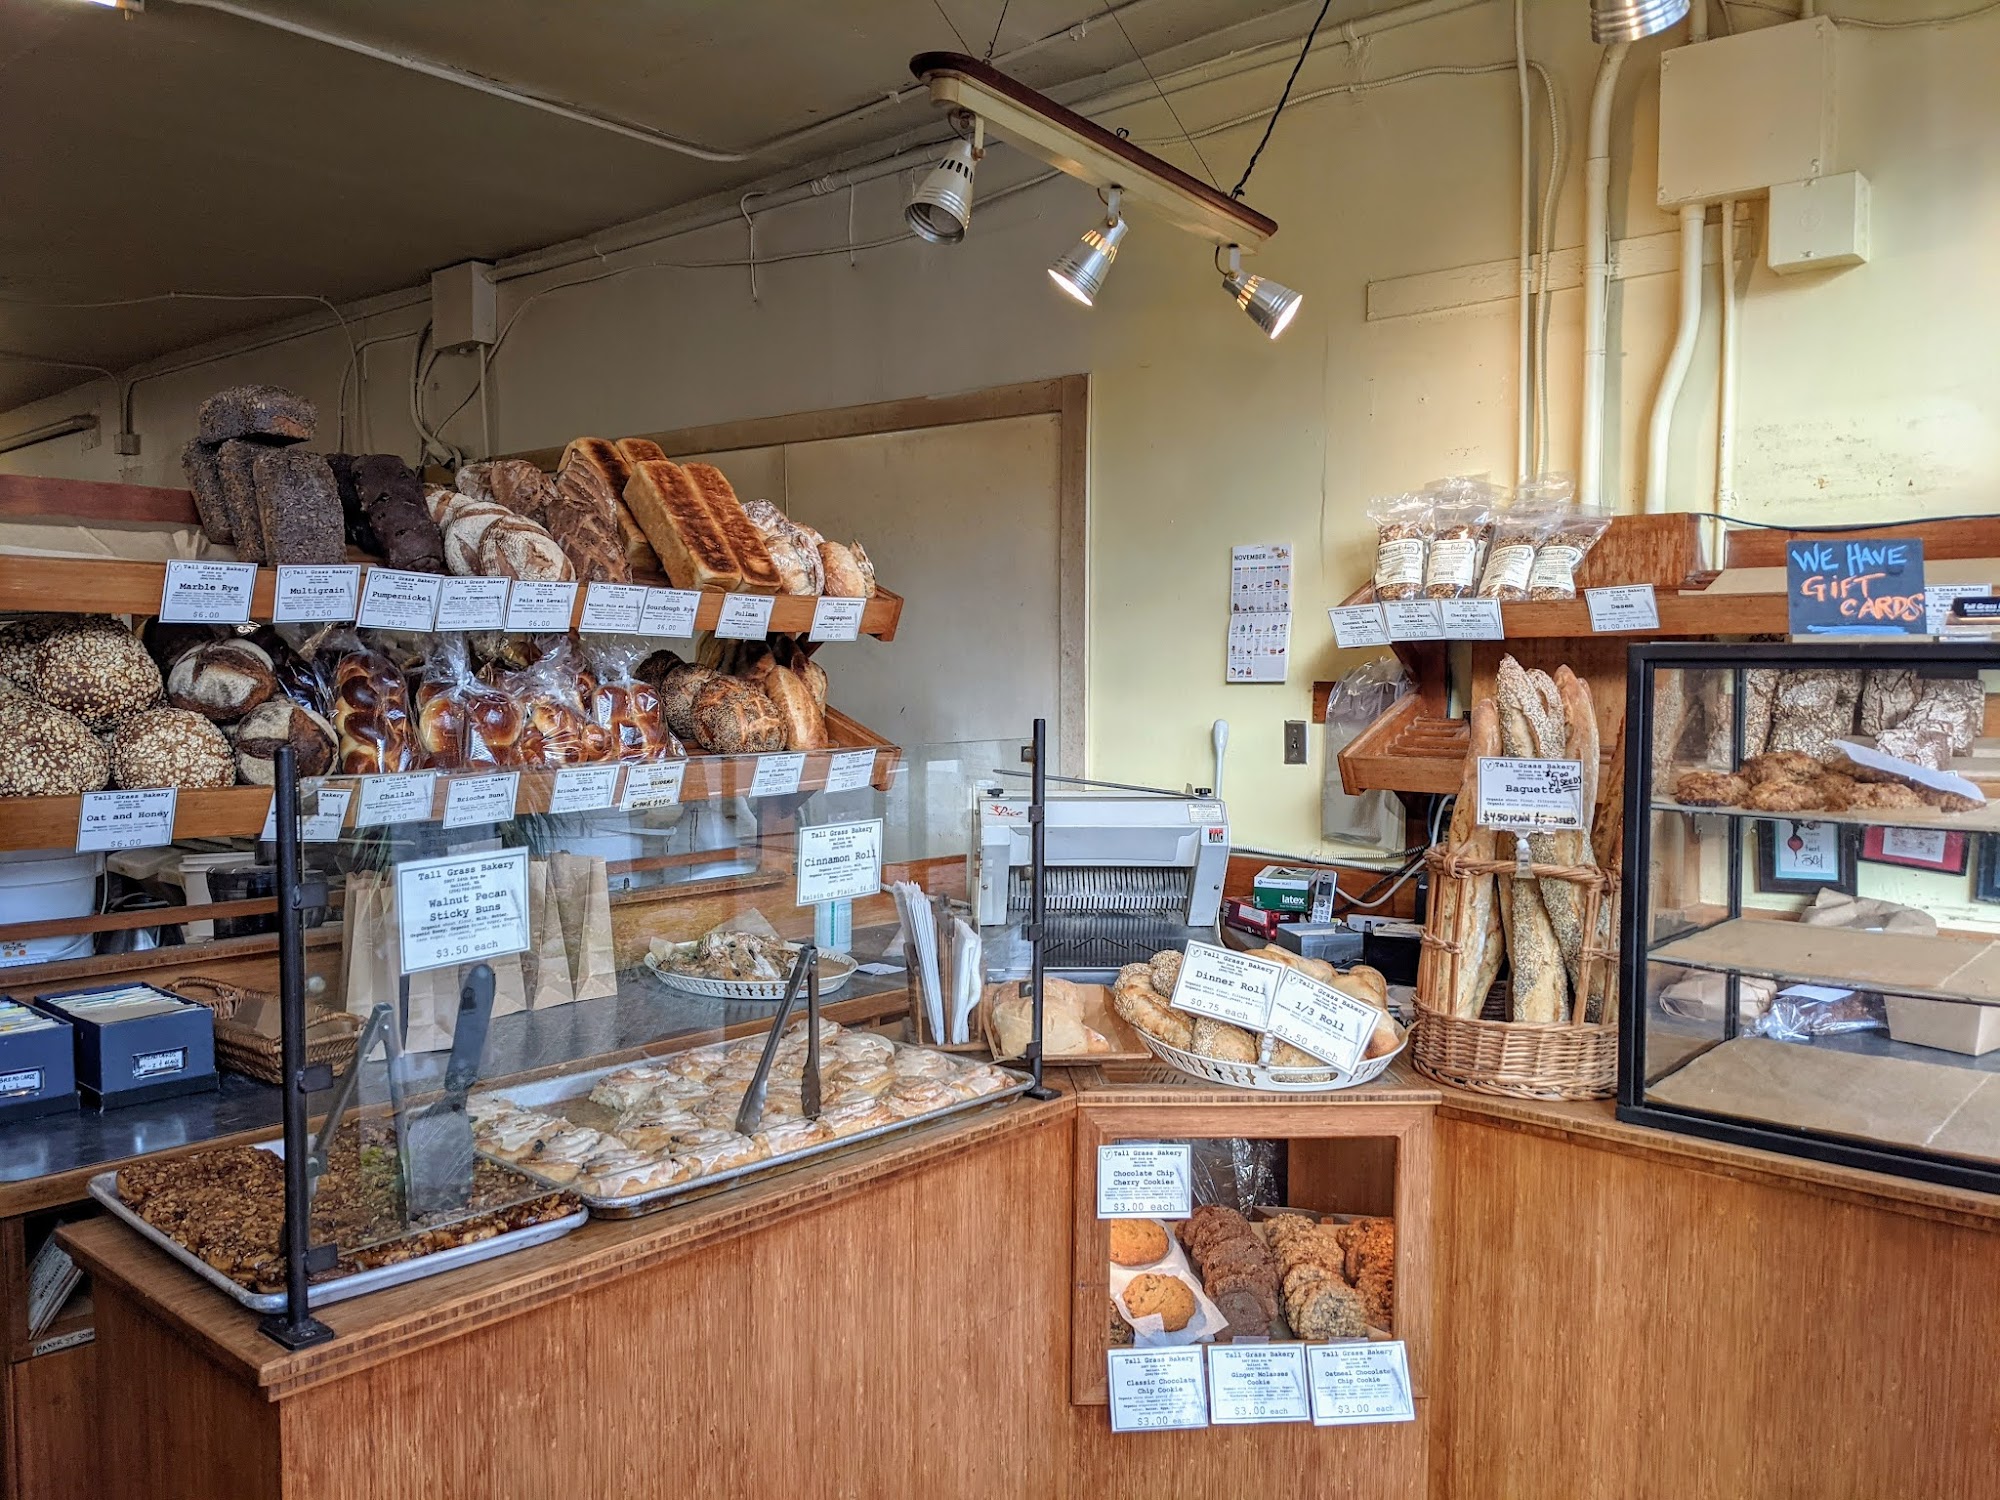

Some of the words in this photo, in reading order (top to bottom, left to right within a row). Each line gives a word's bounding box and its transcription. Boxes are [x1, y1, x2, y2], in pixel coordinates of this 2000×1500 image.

[1792, 543, 1838, 572] WE
[1847, 543, 1908, 575] HAVE
[222, 584, 239, 592] Rye
[290, 587, 345, 595] Multigrain
[372, 591, 431, 601] Pumpernickel
[1840, 593, 1924, 621] CARDS
[380, 791, 415, 800] Challah
[1506, 785, 1562, 794] Baguette
[138, 810, 169, 818] Honey
[1483, 811, 1507, 822] $4.50
[1510, 814, 1530, 822] PLAIN
[111, 839, 141, 847] $6.00
[805, 855, 850, 867] Cinnamon
[855, 849, 876, 860] Roll
[418, 872, 441, 880] Tall
[447, 867, 475, 876] Grass
[482, 861, 514, 871] Bakery
[429, 895, 469, 907] Walnut
[476, 889, 507, 901] Pecan
[1282, 895, 1304, 904] latex
[430, 909, 470, 921] Sticky
[476, 904, 501, 914] Buns
[436, 944, 468, 959] $3.50
[475, 940, 498, 951] each
[1203, 951, 1219, 960] Tall
[1223, 956, 1245, 966] Grass
[1248, 961, 1274, 974] Bakery
[1196, 970, 1235, 991] Dinner
[1240, 982, 1267, 996] Roll
[1298, 979, 1314, 991] Tall
[1317, 987, 1339, 1003] Grass
[1342, 999, 1367, 1017] Bakery
[1191, 997, 1220, 1012] $0.75
[1225, 1007, 1248, 1020] each
[1295, 1001, 1315, 1018] 1/3
[1319, 1012, 1345, 1032] Roll
[1276, 1024, 1308, 1046] $1.50
[1313, 1044, 1339, 1062] each
[1114, 1203, 1144, 1211] $3.00
[1151, 1202, 1175, 1211] each
[36, 1340, 62, 1354] BAKER
[1235, 1406, 1265, 1415] $3.00
[1338, 1404, 1369, 1414] $3.00
[1138, 1416, 1168, 1426] $3.00
